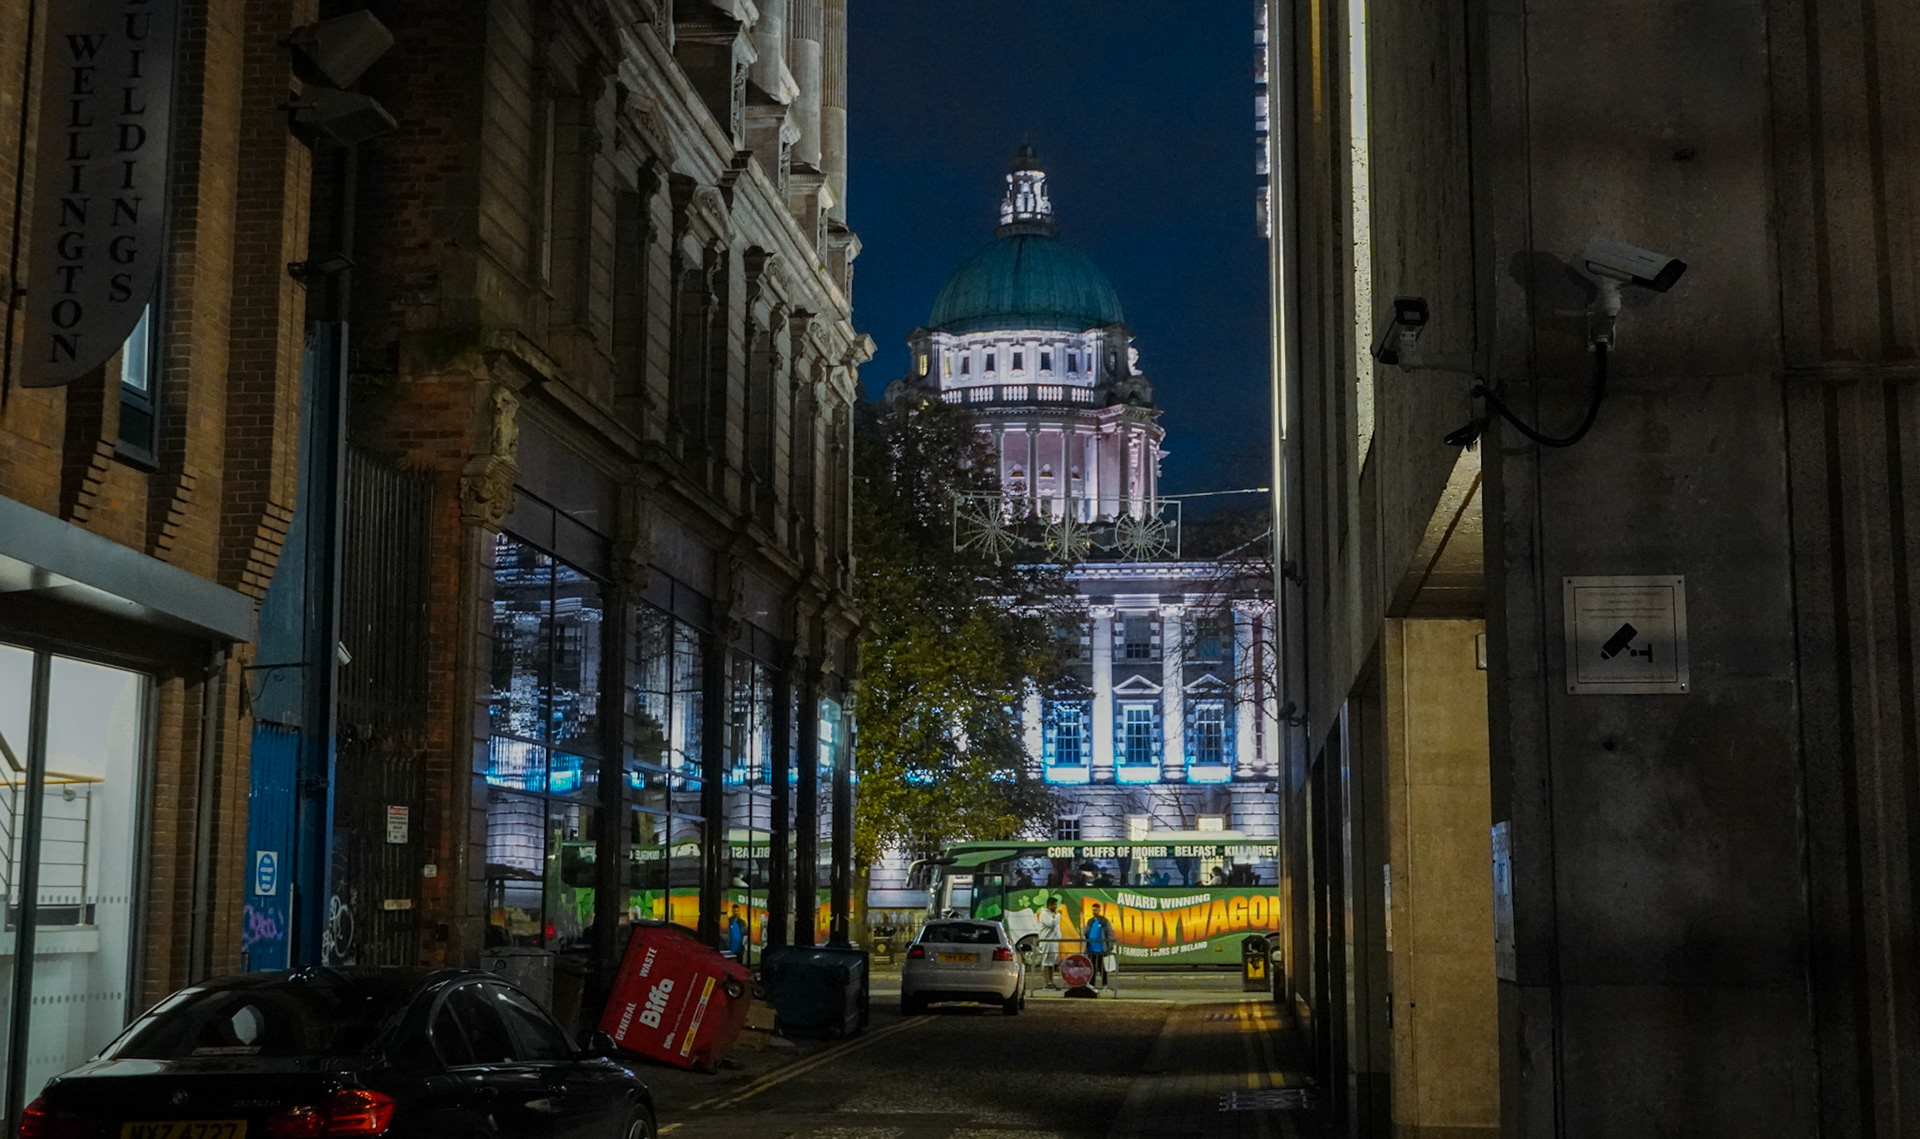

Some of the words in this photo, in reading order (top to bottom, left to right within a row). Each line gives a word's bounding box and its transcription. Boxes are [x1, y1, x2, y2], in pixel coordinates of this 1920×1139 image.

[108, 0, 153, 303] UILDINGS
[48, 33, 108, 363] WELLINGTON
[1047, 846, 1075, 858] CORK
[1082, 846, 1115, 858] CLIFFS
[1117, 846, 1130, 857] OF
[1131, 846, 1167, 857] MOHER
[1174, 845, 1217, 857] BELFAST
[1224, 845, 1278, 857] KILLARNEY
[1117, 892, 1157, 909] AWARD
[1160, 893, 1211, 909] WINNING
[1122, 946, 1149, 957] FAMOUS
[1171, 946, 1179, 955] OF
[1180, 941, 1208, 953] IRELAND
[615, 1002, 637, 1041] GENERAL
[639, 947, 658, 977] WASTE
[639, 978, 674, 1029] Biffa
